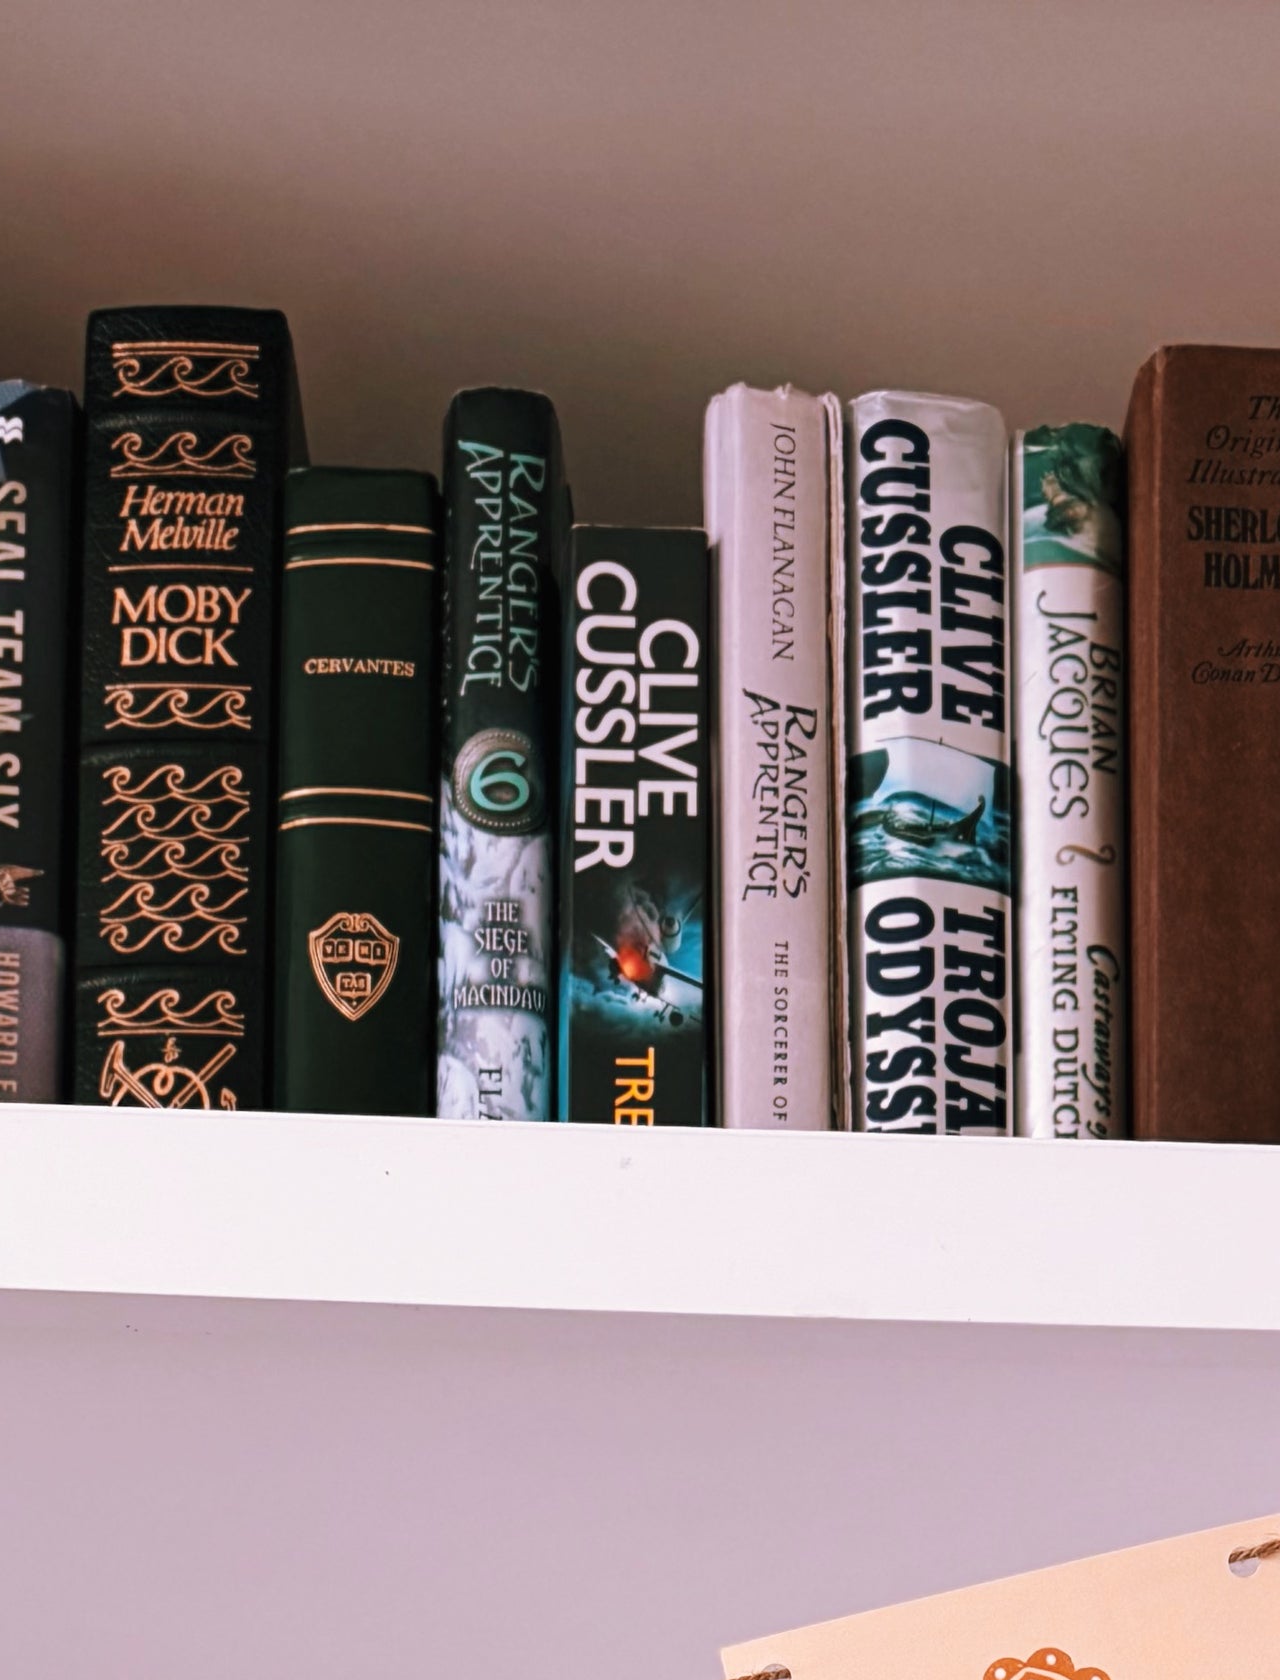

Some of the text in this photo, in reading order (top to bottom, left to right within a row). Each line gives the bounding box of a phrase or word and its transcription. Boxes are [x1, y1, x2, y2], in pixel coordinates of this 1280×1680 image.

[119, 484, 245, 518] Herman
[119, 517, 240, 551] Melville
[769, 422, 797, 661] JOHN FLANAGAN
[111, 584, 253, 625] MOBY
[457, 439, 504, 697] APPRENTICE
[506, 452, 547, 693] RANGER'S
[859, 418, 933, 722] CUSSLER
[120, 626, 240, 667] DICK
[303, 656, 416, 679] CERVANTES
[938, 524, 1006, 734] CLIVE
[1191, 660, 1257, 686] Conan
[573, 560, 638, 874] CUSSLER
[637, 618, 701, 817] CLIVE
[1088, 641, 1120, 775] BRIAN
[469, 750, 531, 812] 6
[741, 687, 782, 902] APPRENTICE
[782, 703, 818, 900] RANGER'S
[473, 927, 528, 956] SIEGE
[483, 901, 520, 923] THE
[1051, 885, 1079, 1012] FLYING
[453, 983, 547, 1012] MACINDAW
[489, 957, 514, 980] OF
[772, 940, 789, 1122] THE SORCERER OF
[614, 1046, 655, 1126] TRE
